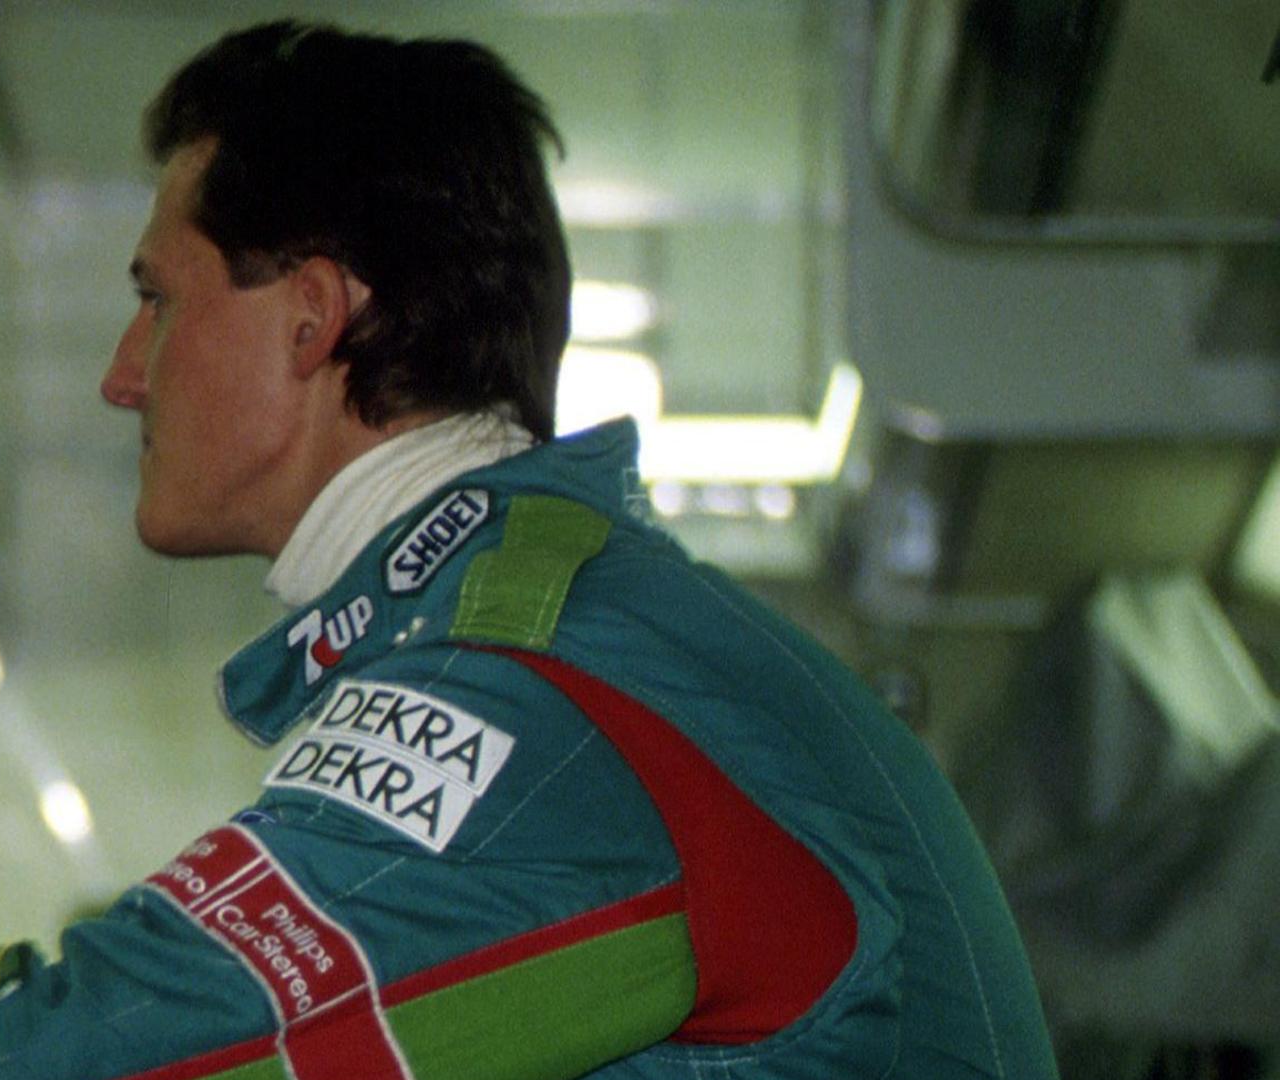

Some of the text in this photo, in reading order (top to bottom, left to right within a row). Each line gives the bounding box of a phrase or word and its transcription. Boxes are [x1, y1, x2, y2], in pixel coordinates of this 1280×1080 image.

[393, 489, 483, 583] SHOEI
[320, 684, 486, 784] DEKRA
[276, 740, 447, 838] DEKRA
[260, 902, 335, 974] Philips
